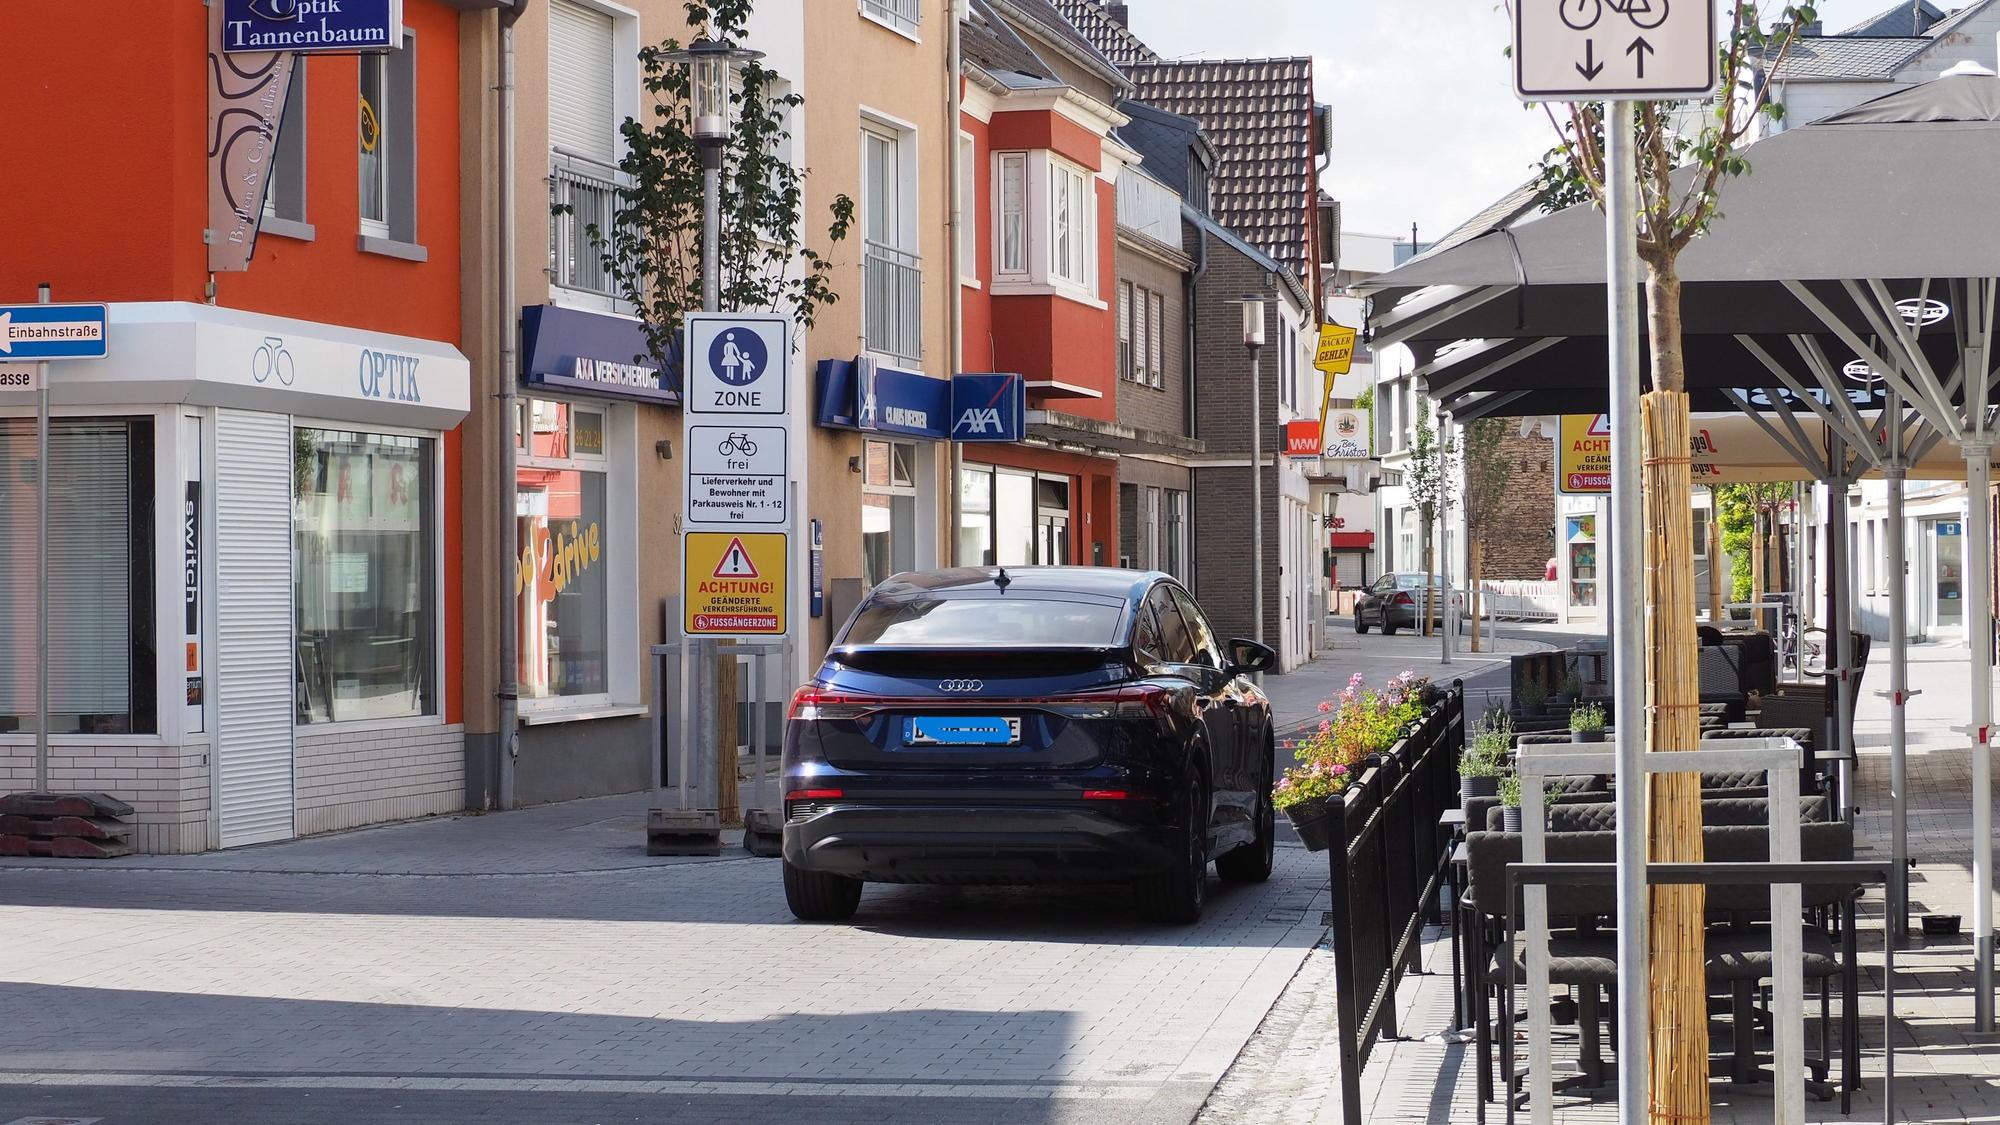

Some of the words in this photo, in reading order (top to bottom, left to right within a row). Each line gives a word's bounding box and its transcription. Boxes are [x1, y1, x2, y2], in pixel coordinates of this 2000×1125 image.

[228, 17, 385, 46] Tannenbaum
[247, 60, 283, 164] Contactlinsen
[243, 167, 258, 187] &
[229, 191, 254, 249] Brillen
[9, 325, 98, 338] Einbahnstraße
[1321, 336, 1351, 347] BÄCKER
[1320, 348, 1350, 361] GEHLEN
[359, 348, 421, 402] OPTIK
[575, 357, 594, 381] AXA
[595, 361, 660, 389] VERSICHERUNG
[714, 391, 761, 406] ZONE
[952, 408, 1004, 433] AXA
[1341, 439, 1357, 448] Bei
[1327, 444, 1367, 457] Christos
[728, 458, 749, 469] frei
[702, 477, 756, 486] Lieferverkehr
[758, 478, 773, 486] und
[709, 488, 750, 497] Bewohner
[752, 489, 765, 497] mit
[692, 499, 744, 508] Parkausweis
[746, 500, 757, 508] Nr.
[760, 500, 764, 508] 1
[772, 500, 782, 508] 12
[730, 511, 744, 519] frei
[186, 500, 197, 603] switch
[699, 581, 774, 593] ACHTUNG!
[711, 596, 761, 605] GEÄNDERTE
[702, 605, 773, 613] VERKEHRSFÜHRUNG
[709, 616, 776, 627] FUSSGÄNGERZONE
